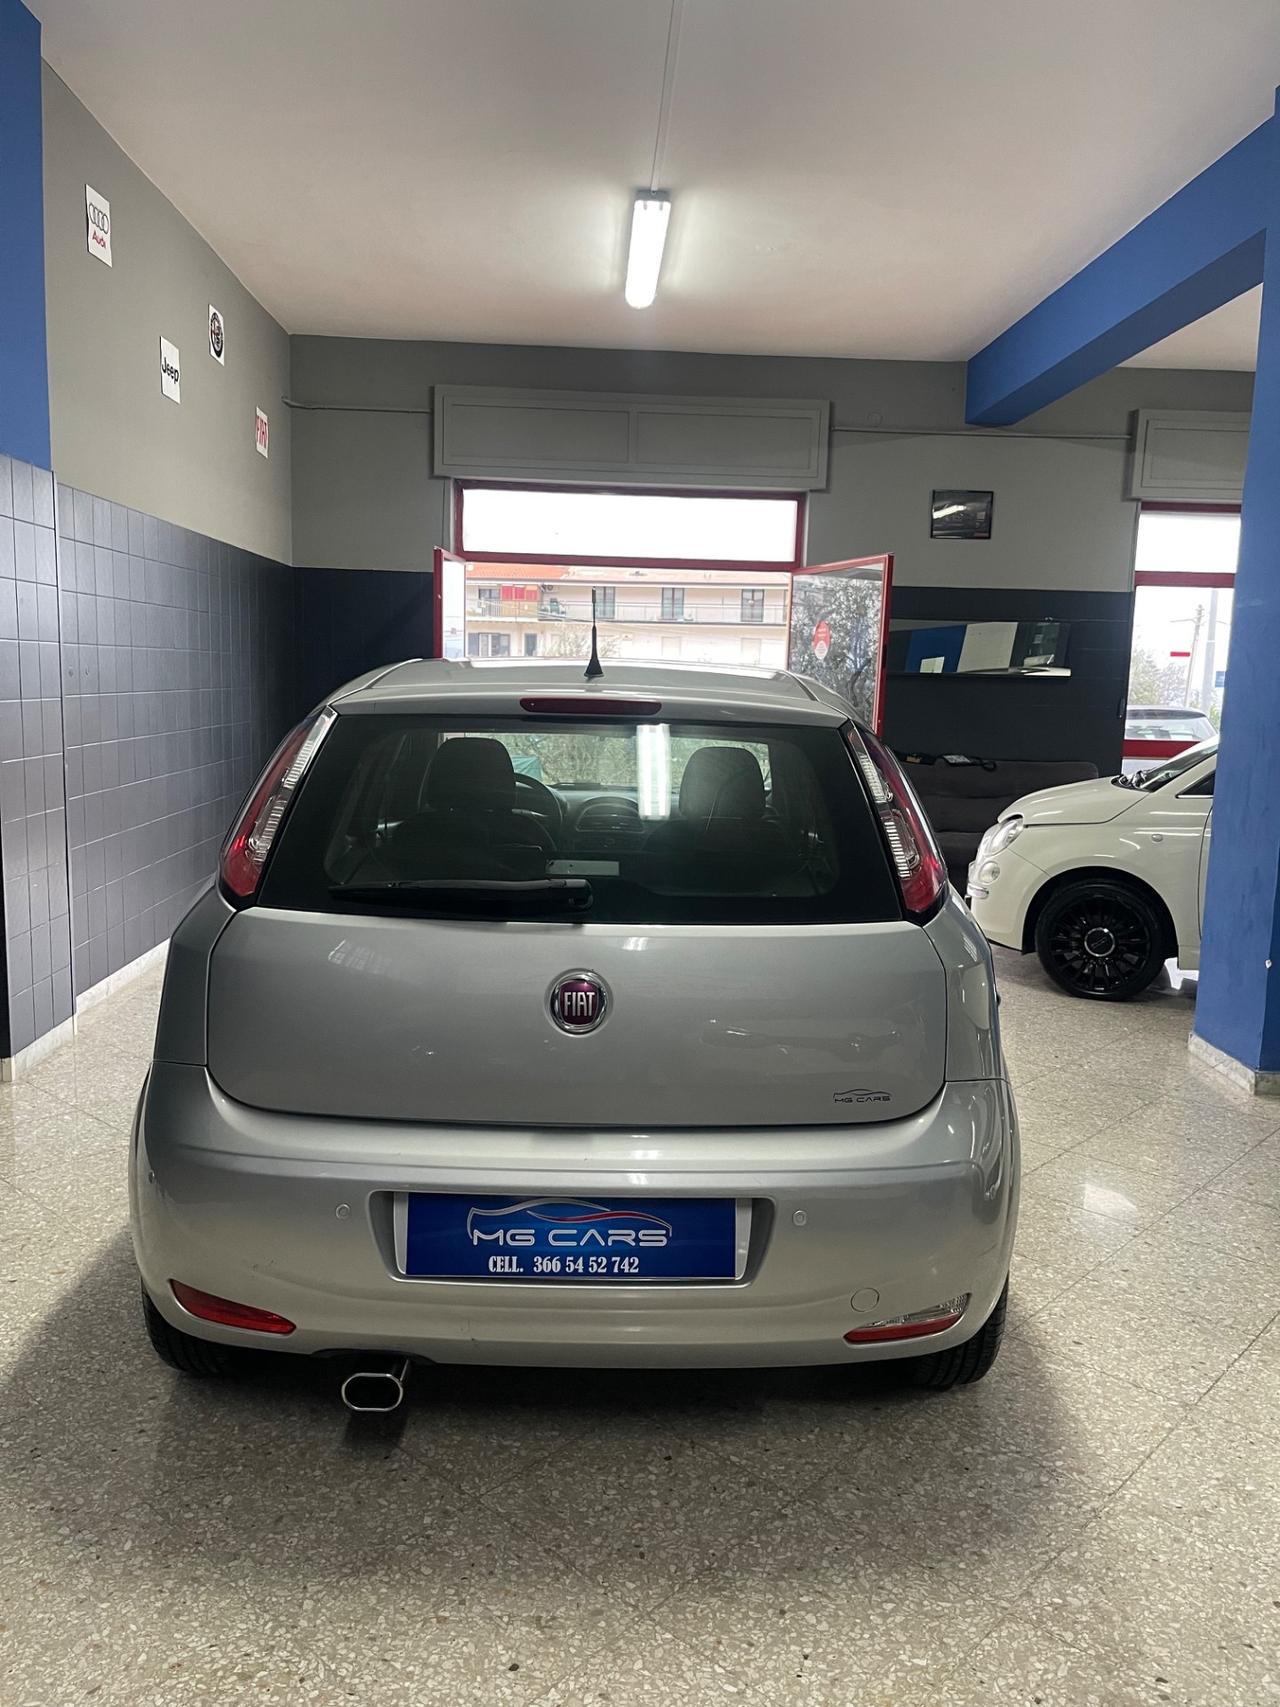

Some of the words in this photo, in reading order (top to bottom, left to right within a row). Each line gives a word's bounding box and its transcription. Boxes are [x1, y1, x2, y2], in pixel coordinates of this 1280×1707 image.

[92, 231, 106, 248] Audi
[161, 357, 179, 383] Jeep
[564, 992, 595, 1017] FIAT
[473, 1229, 535, 1246] MG
[548, 1229, 667, 1247] CARS
[489, 1256, 523, 1273] CELL.
[533, 1256, 562, 1274] 366
[565, 1256, 584, 1274] 54
[589, 1256, 608, 1274] 52
[611, 1256, 640, 1274] 742
